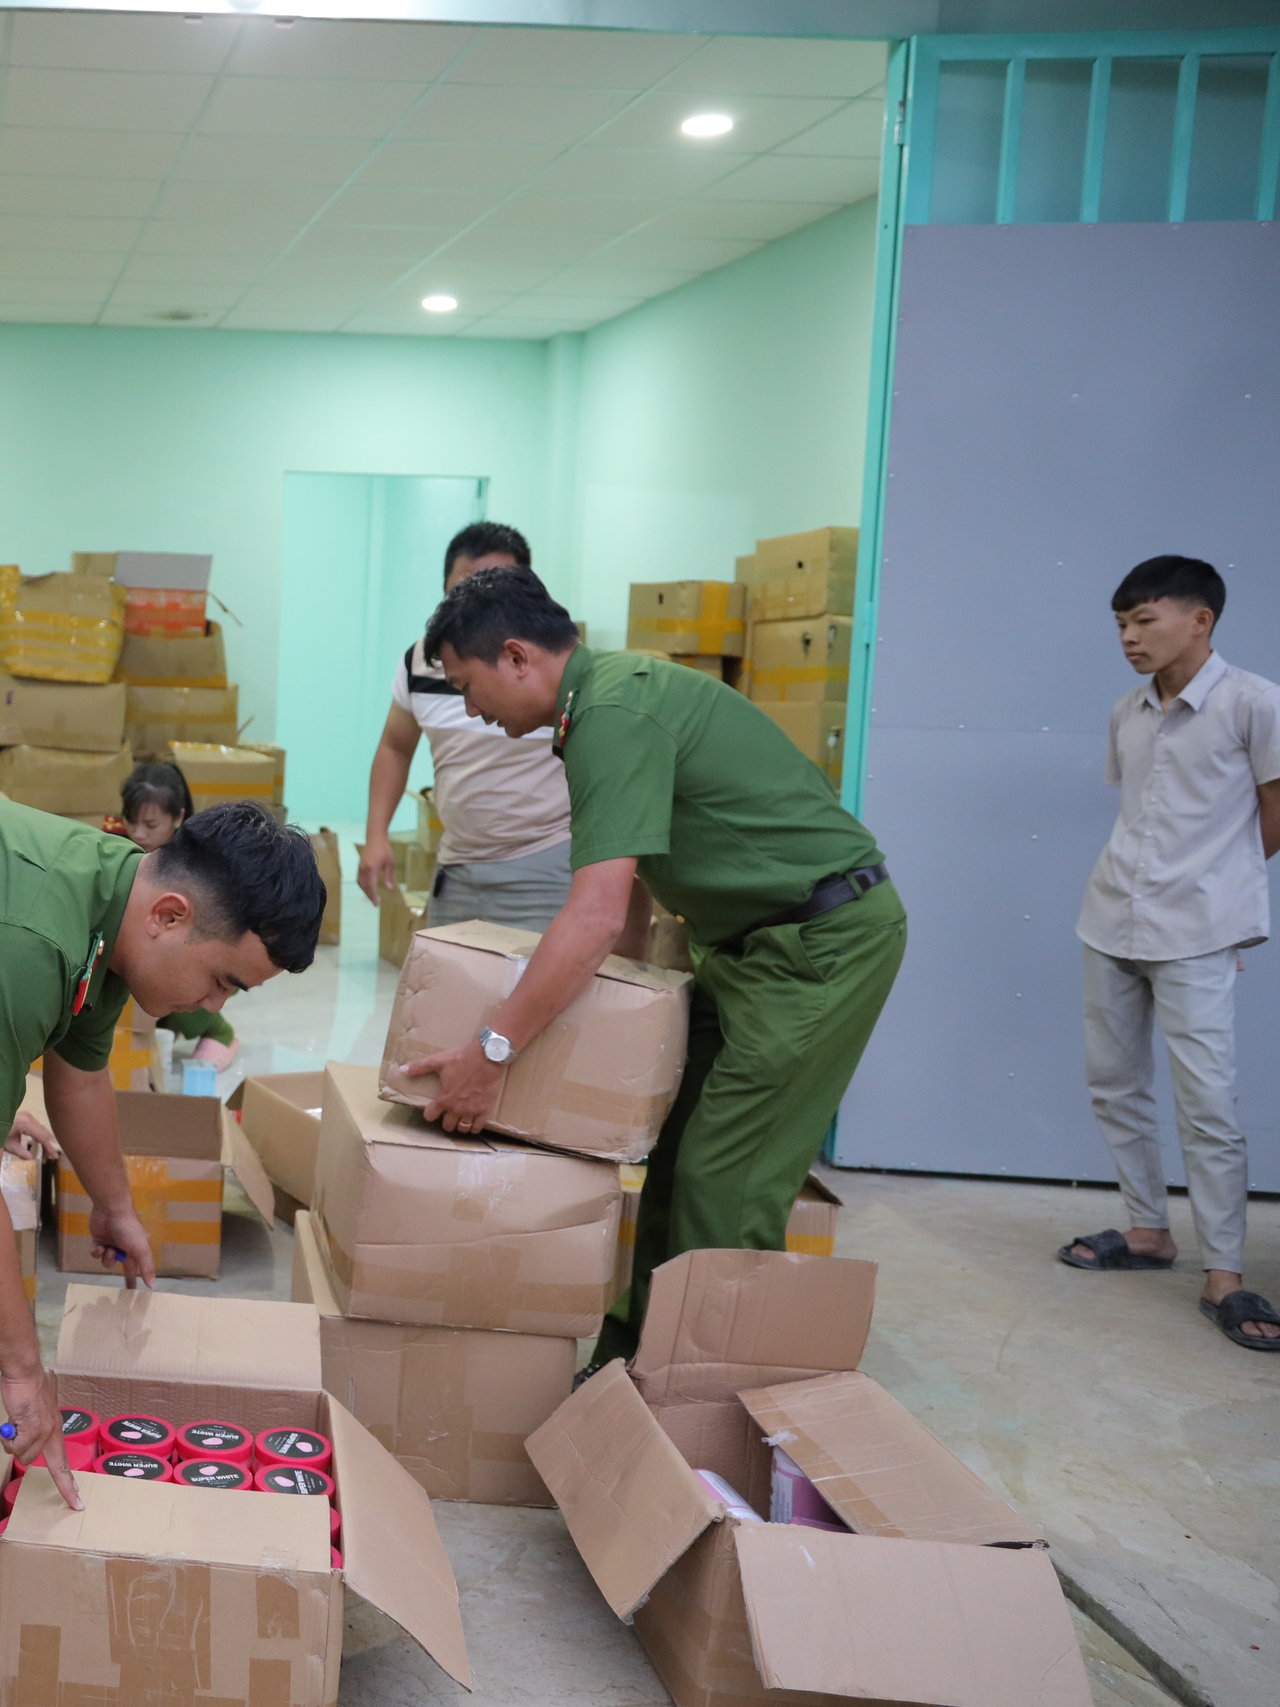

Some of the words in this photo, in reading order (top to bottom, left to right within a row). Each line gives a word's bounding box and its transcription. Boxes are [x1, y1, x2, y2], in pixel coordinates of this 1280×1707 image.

[122, 1420, 141, 1431] WHITE
[141, 1428, 162, 1439] SUPER
[191, 1429, 214, 1438] WHITE
[215, 1432, 239, 1440] SUPER
[285, 1432, 298, 1445] SUPER
[278, 1443, 290, 1454] WHITE
[294, 1470, 304, 1482] WHITE
[298, 1482, 308, 1494] SUPER
